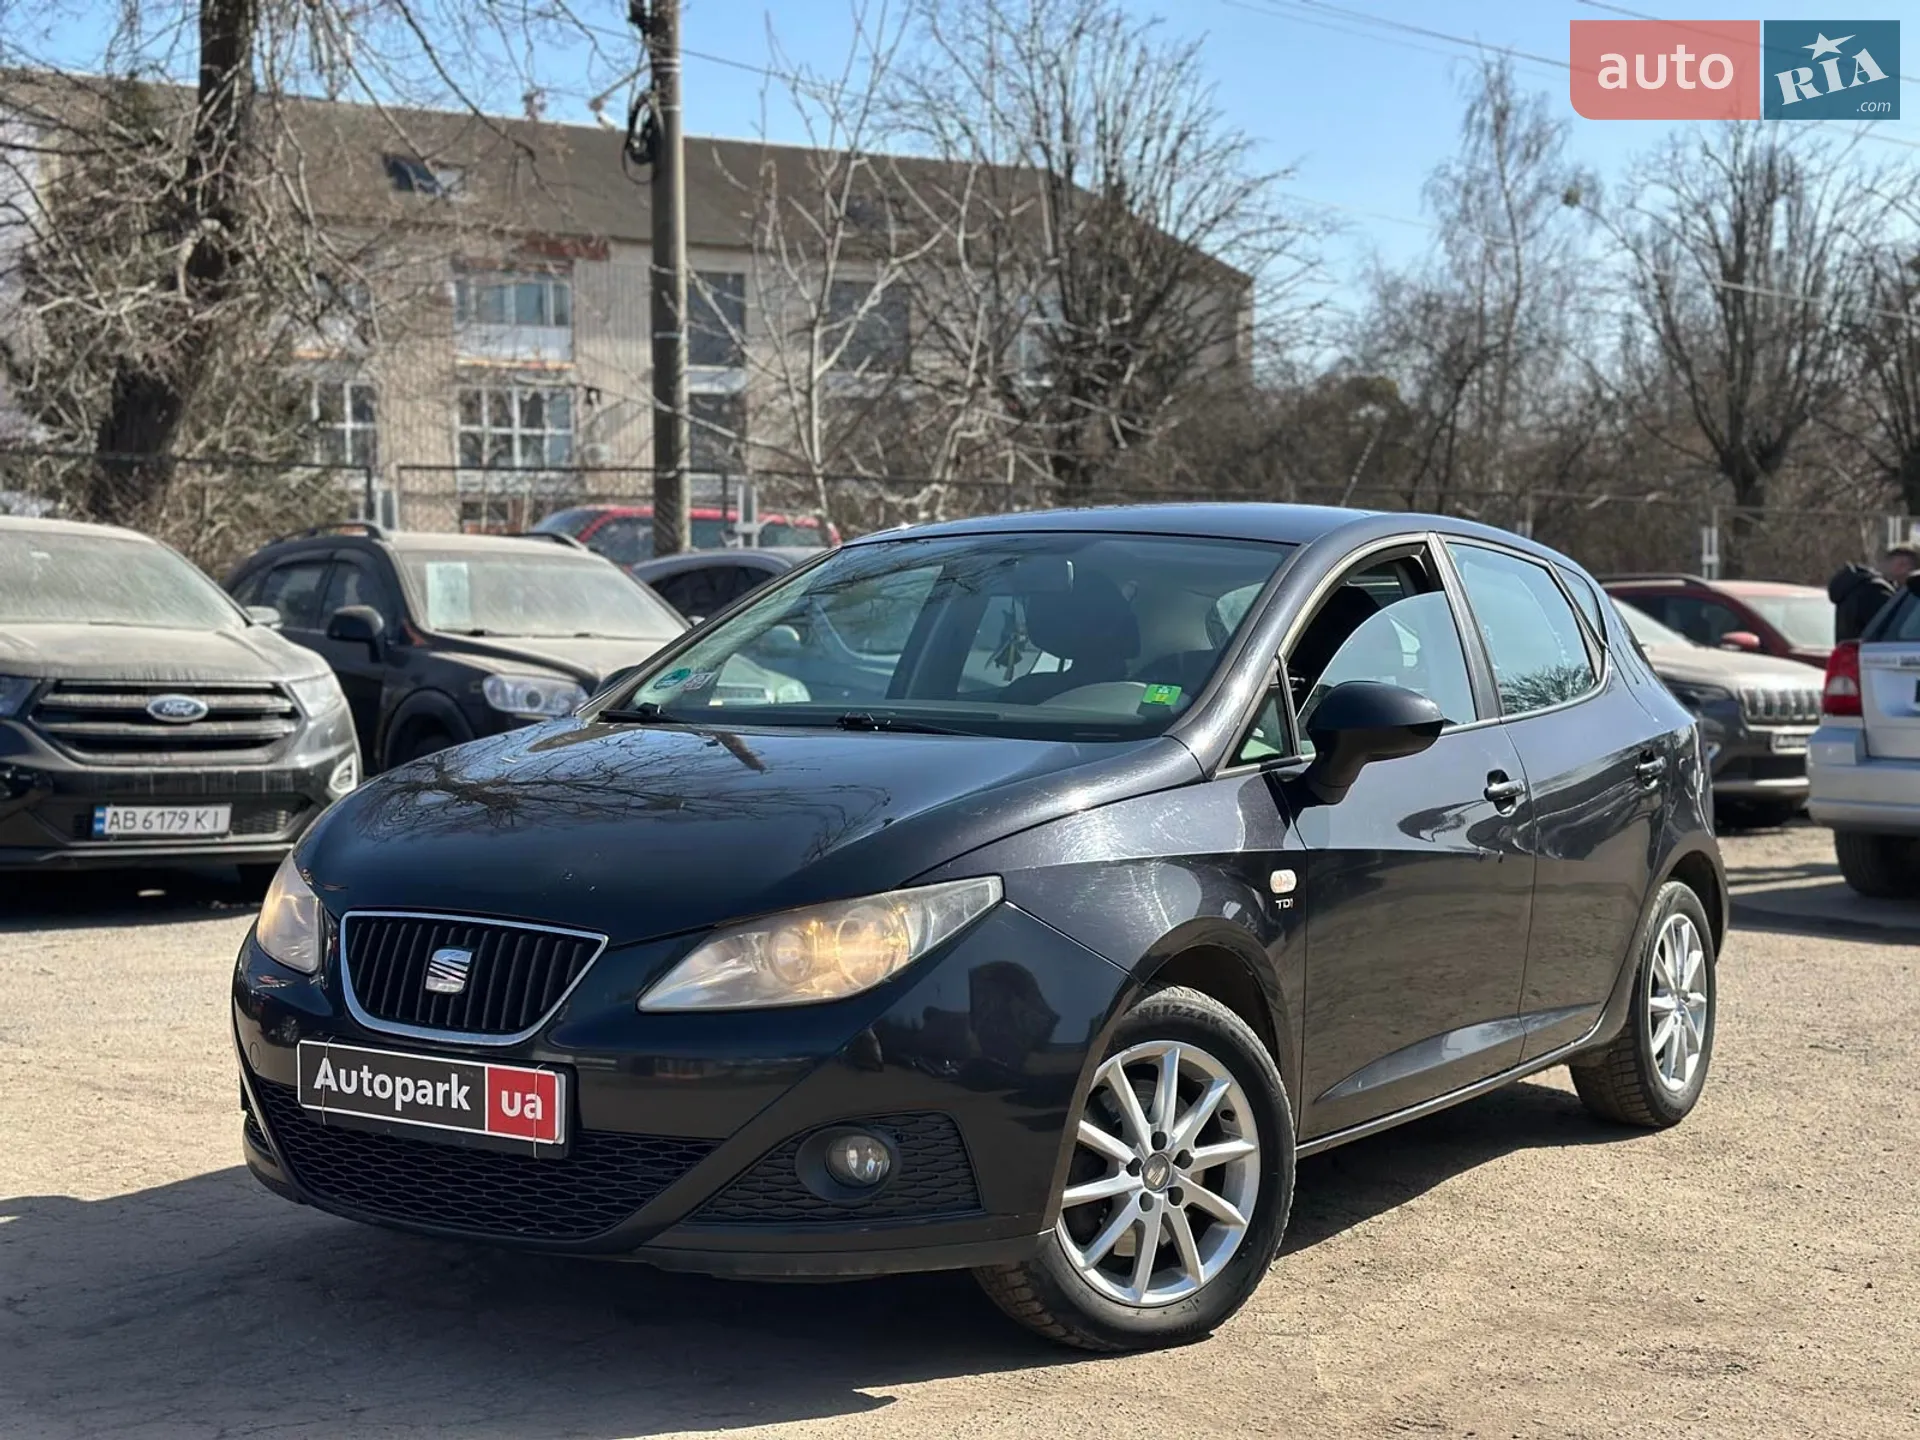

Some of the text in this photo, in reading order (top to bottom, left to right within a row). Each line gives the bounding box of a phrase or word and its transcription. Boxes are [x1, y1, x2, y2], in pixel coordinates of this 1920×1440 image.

[161, 701, 195, 716] Ford
[108, 811, 137, 830] AB
[142, 811, 190, 830] 6179
[313, 1057, 542, 1120] Autopark ua
